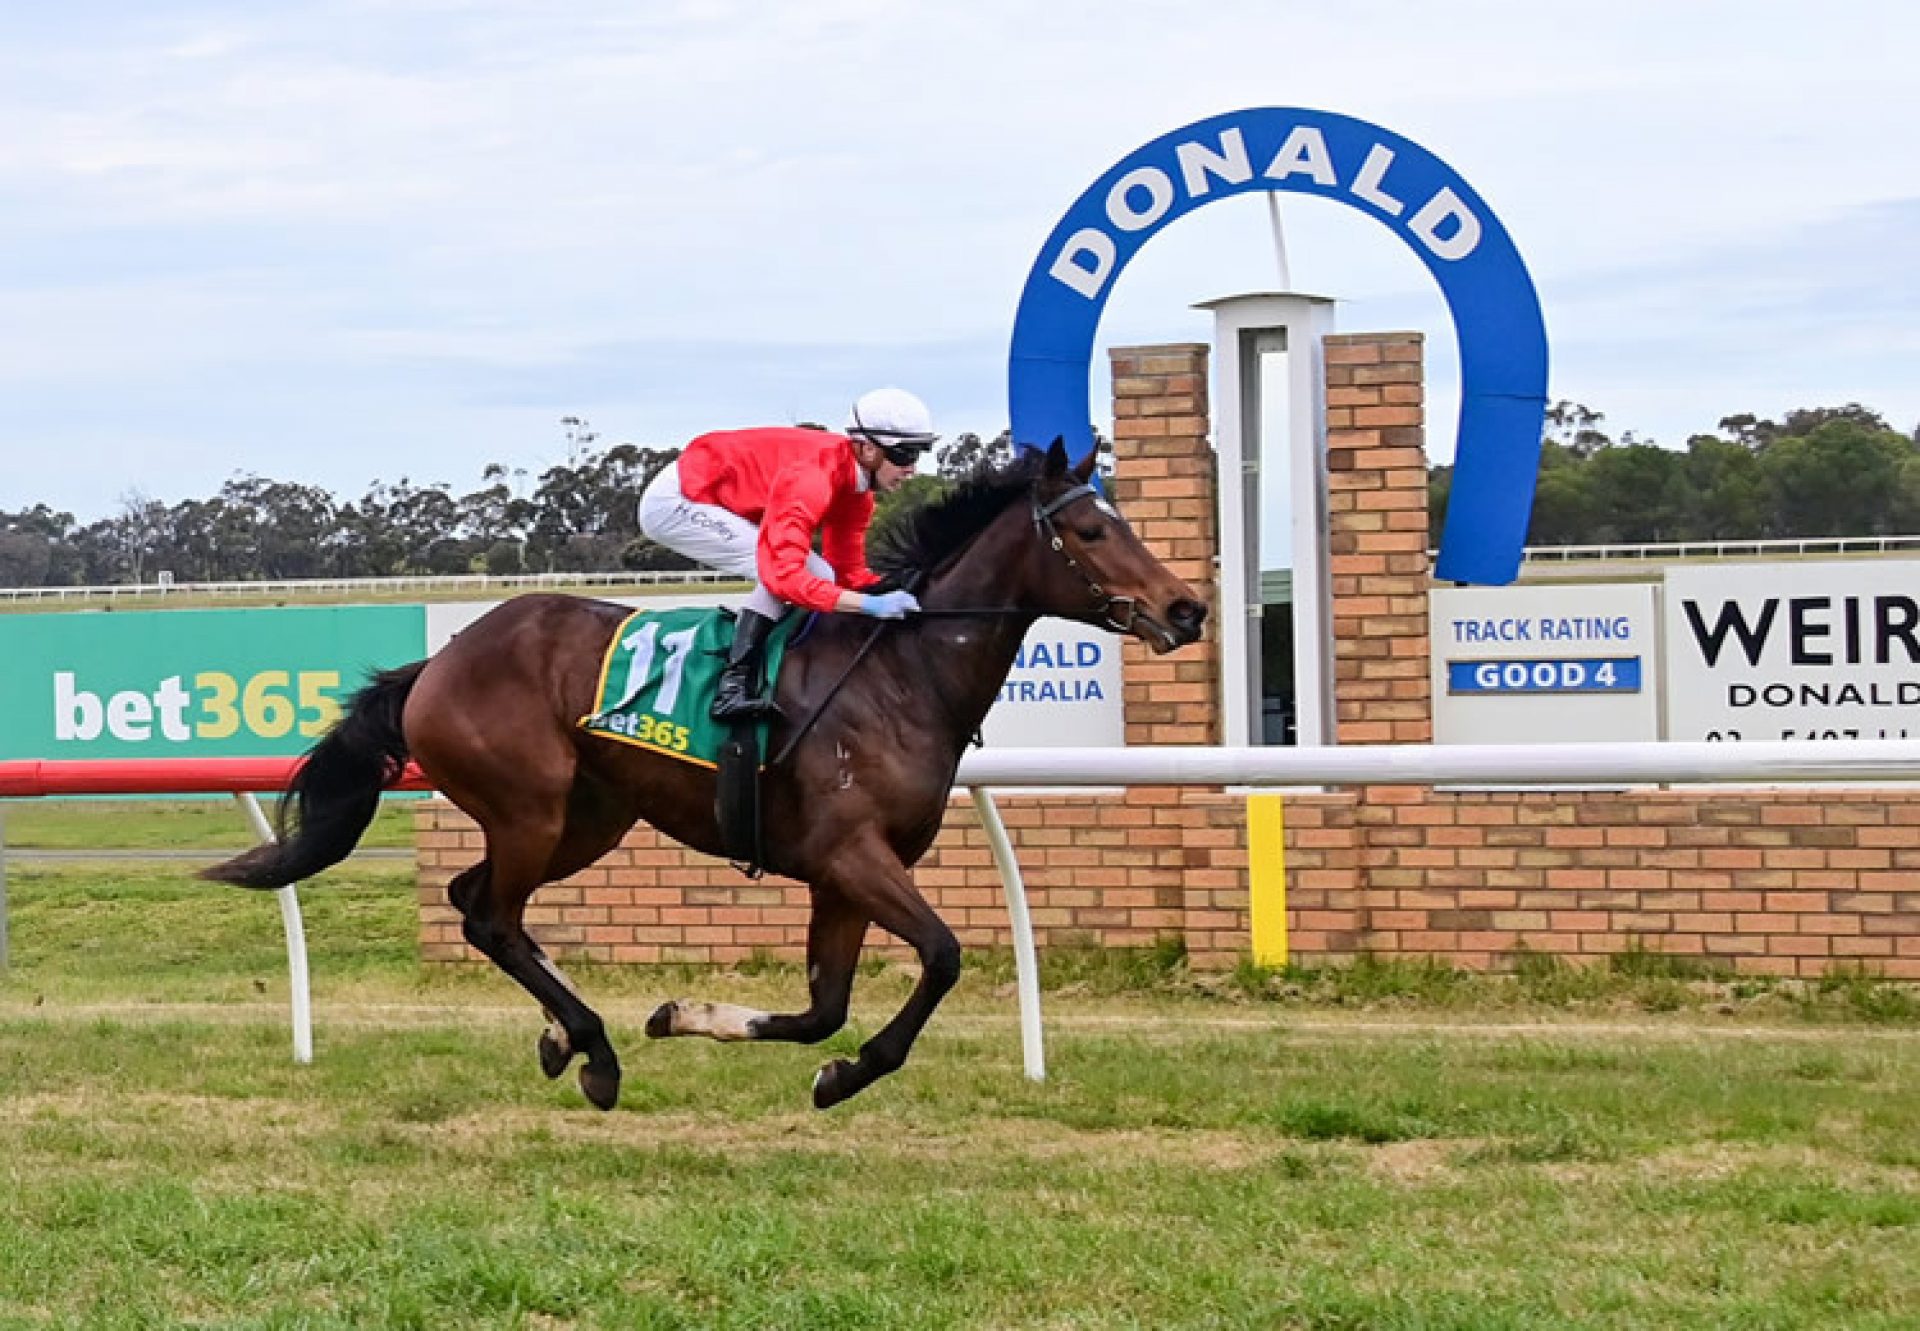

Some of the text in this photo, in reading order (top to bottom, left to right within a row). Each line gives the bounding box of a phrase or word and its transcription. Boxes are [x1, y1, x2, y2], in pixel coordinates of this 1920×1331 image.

[1049, 125, 1483, 300] DONALD
[1453, 616, 1631, 643] TRACK RATING
[1681, 596, 1920, 668] WEIR
[614, 620, 698, 715] 11
[1015, 641, 1102, 669] ALD
[1474, 662, 1618, 688] GOOD 4
[996, 679, 1104, 702] TRALIA
[1728, 682, 1920, 707] DONALD
[53, 670, 345, 741] bet365
